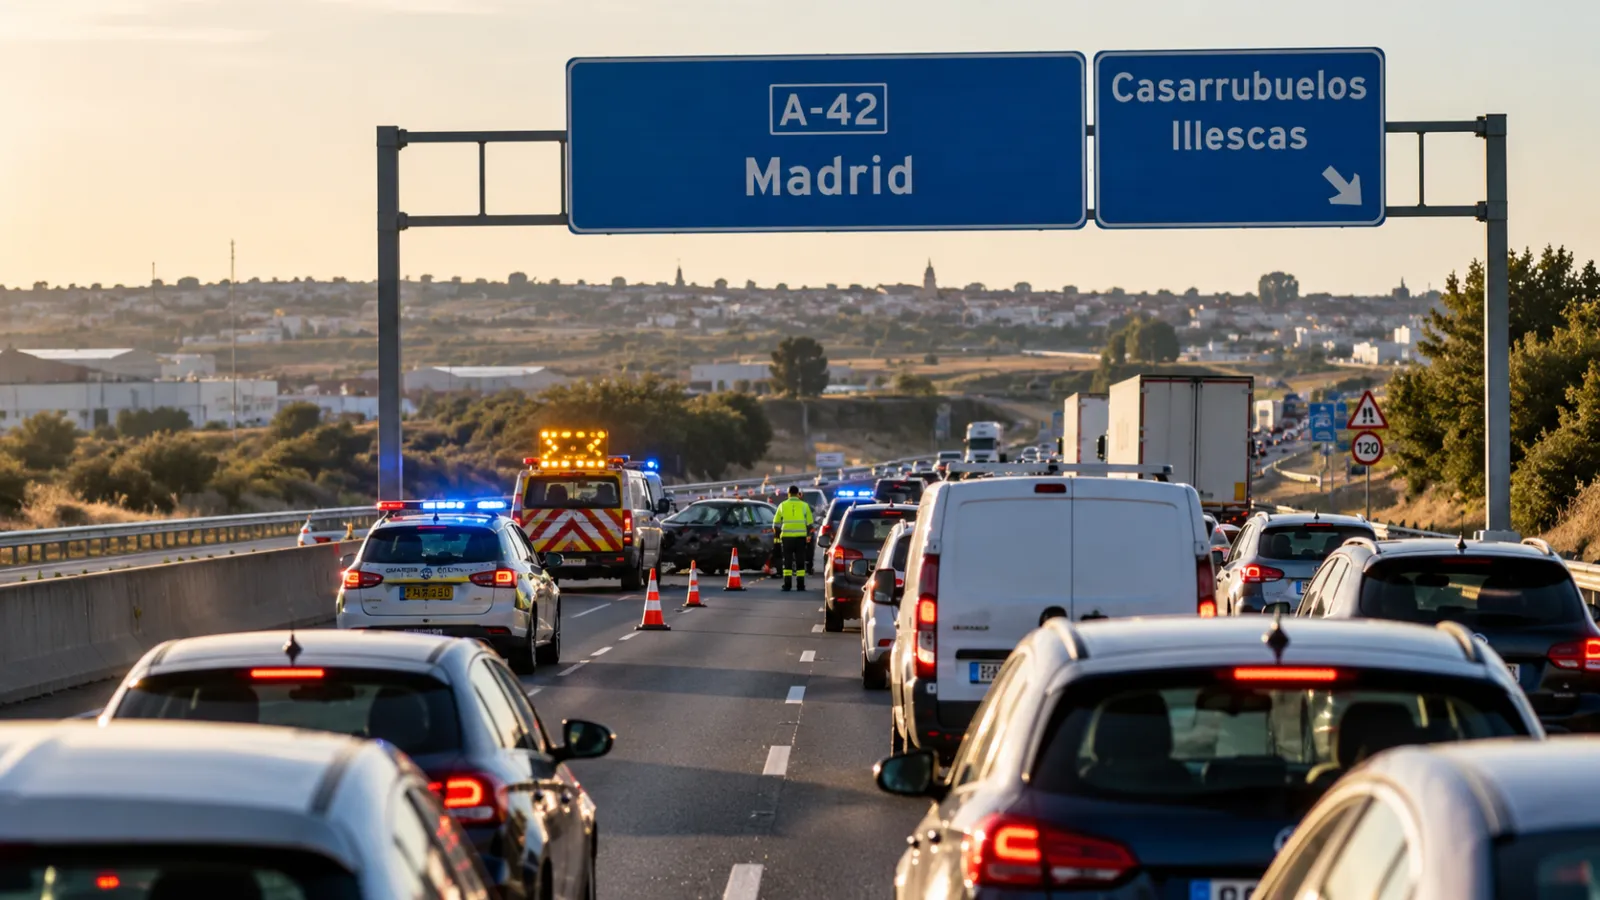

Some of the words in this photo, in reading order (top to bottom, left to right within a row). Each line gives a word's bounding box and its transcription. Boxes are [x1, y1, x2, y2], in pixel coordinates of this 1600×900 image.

[1112, 70, 1367, 103] Casarrubuelos
[780, 94, 877, 125] A-42
[1173, 120, 1307, 151] Illescas
[746, 155, 912, 196] Madrid
[1357, 442, 1379, 454] 120
